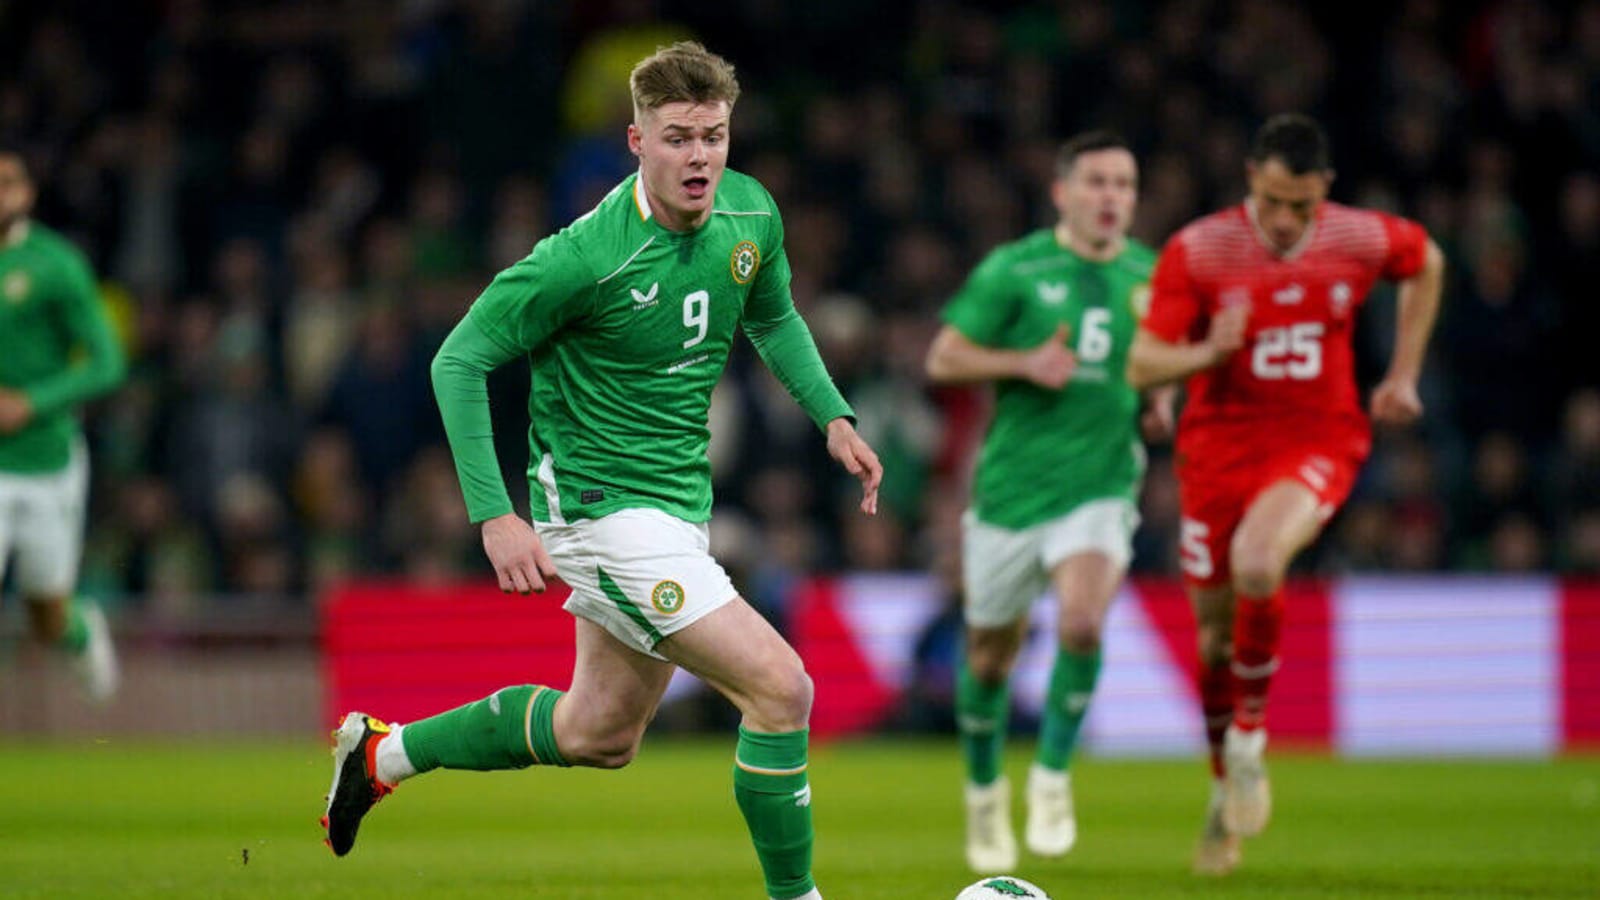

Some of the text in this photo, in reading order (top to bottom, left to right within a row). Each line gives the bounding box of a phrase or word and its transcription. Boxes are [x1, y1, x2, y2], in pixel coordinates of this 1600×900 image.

[683, 290, 709, 349] 9
[1079, 307, 1112, 361] 6
[1252, 322, 1325, 379] 25
